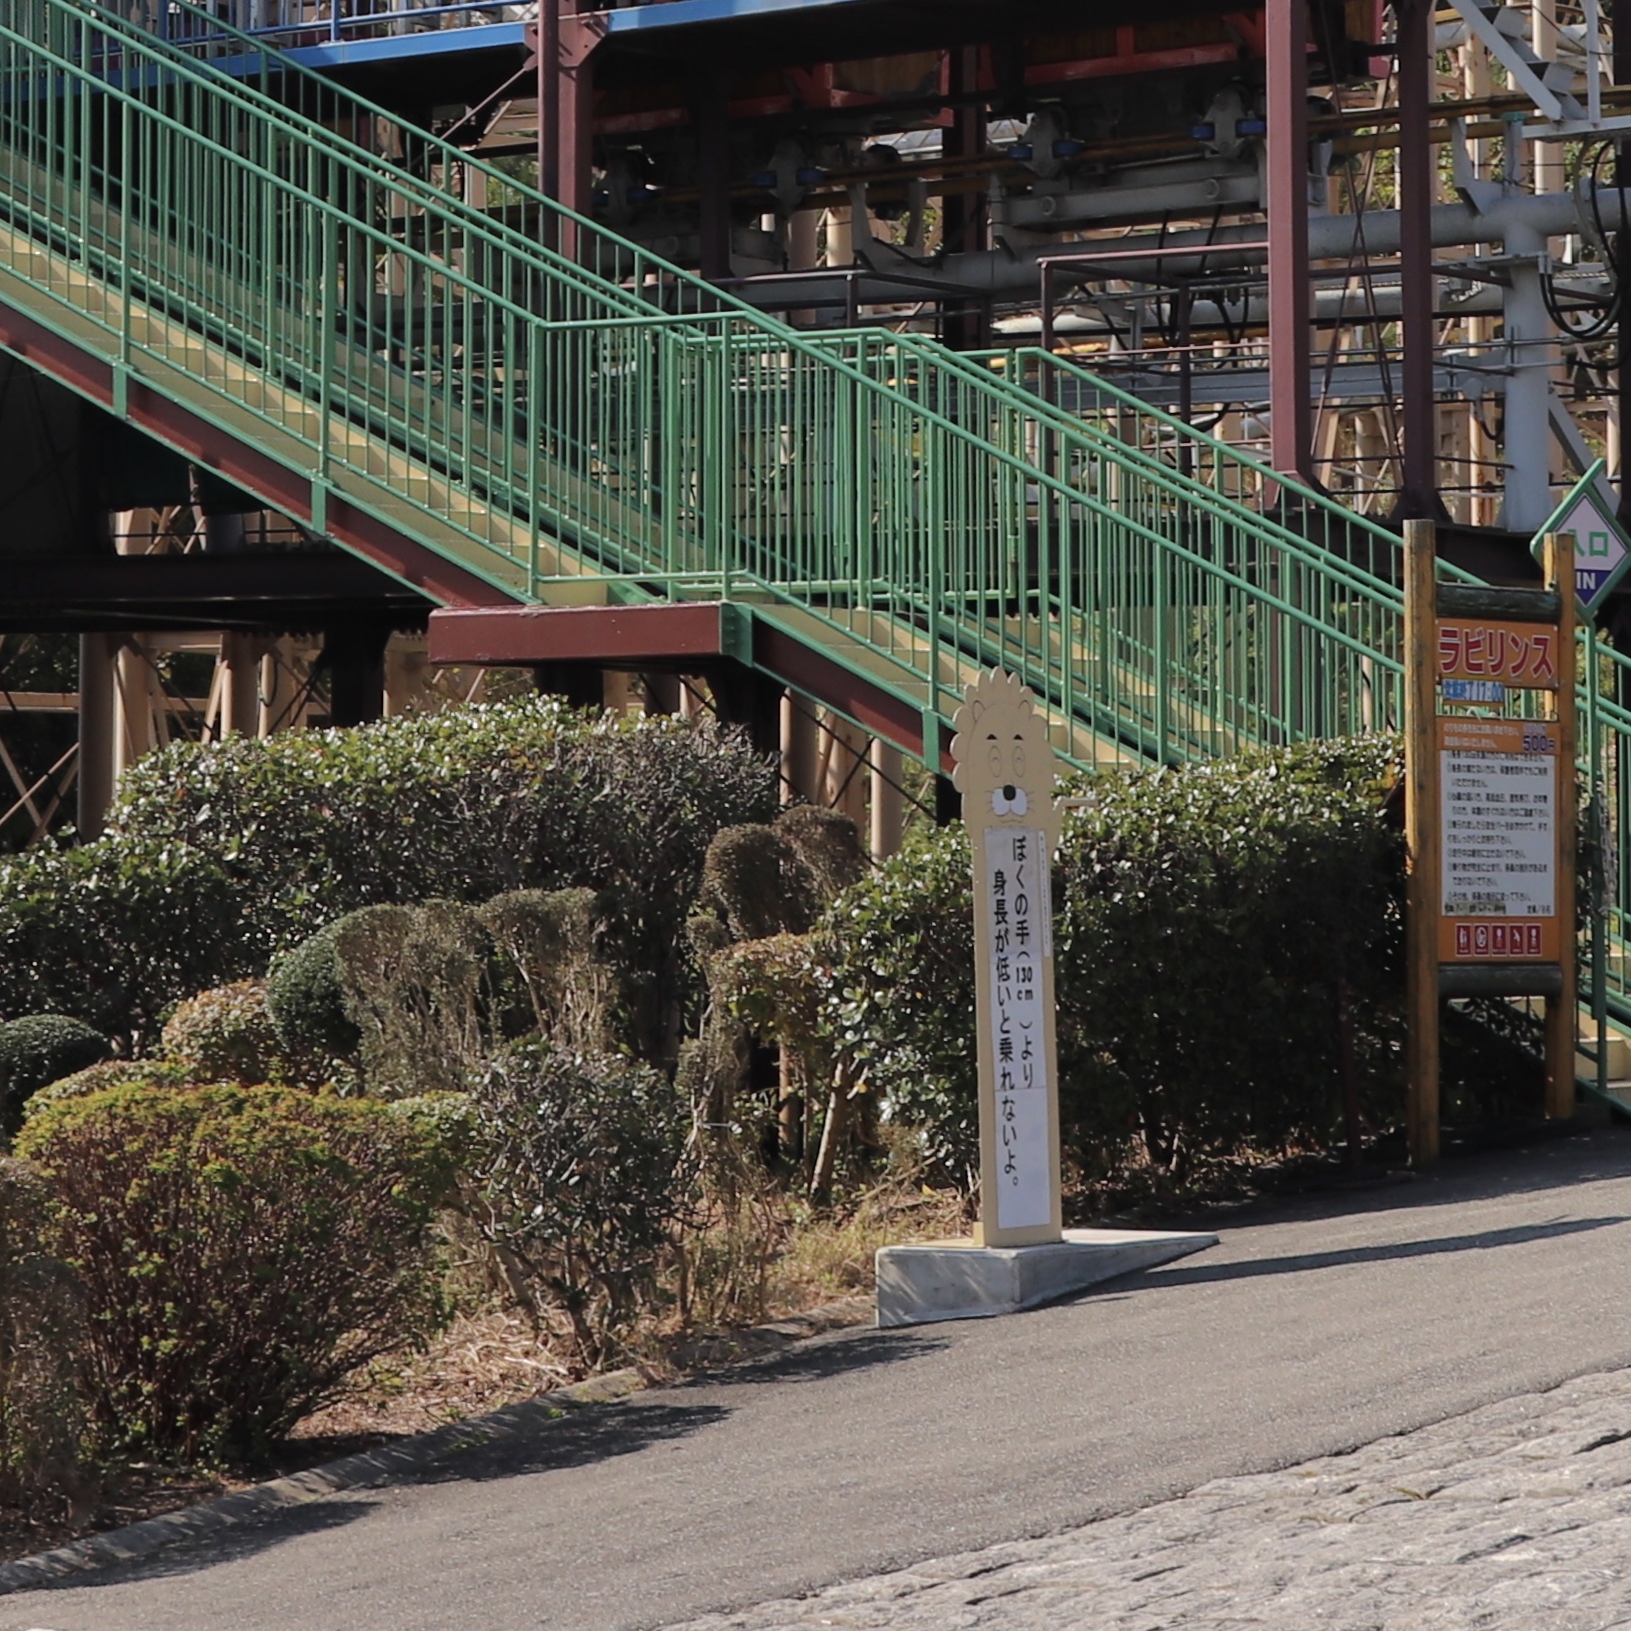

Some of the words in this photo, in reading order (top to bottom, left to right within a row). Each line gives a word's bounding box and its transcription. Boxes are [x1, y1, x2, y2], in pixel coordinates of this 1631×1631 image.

[1576, 571, 1597, 590] IN
[1439, 626, 1554, 679] ラビリンス
[993, 868, 1019, 1187] 身長が低いと乗れないよ。
